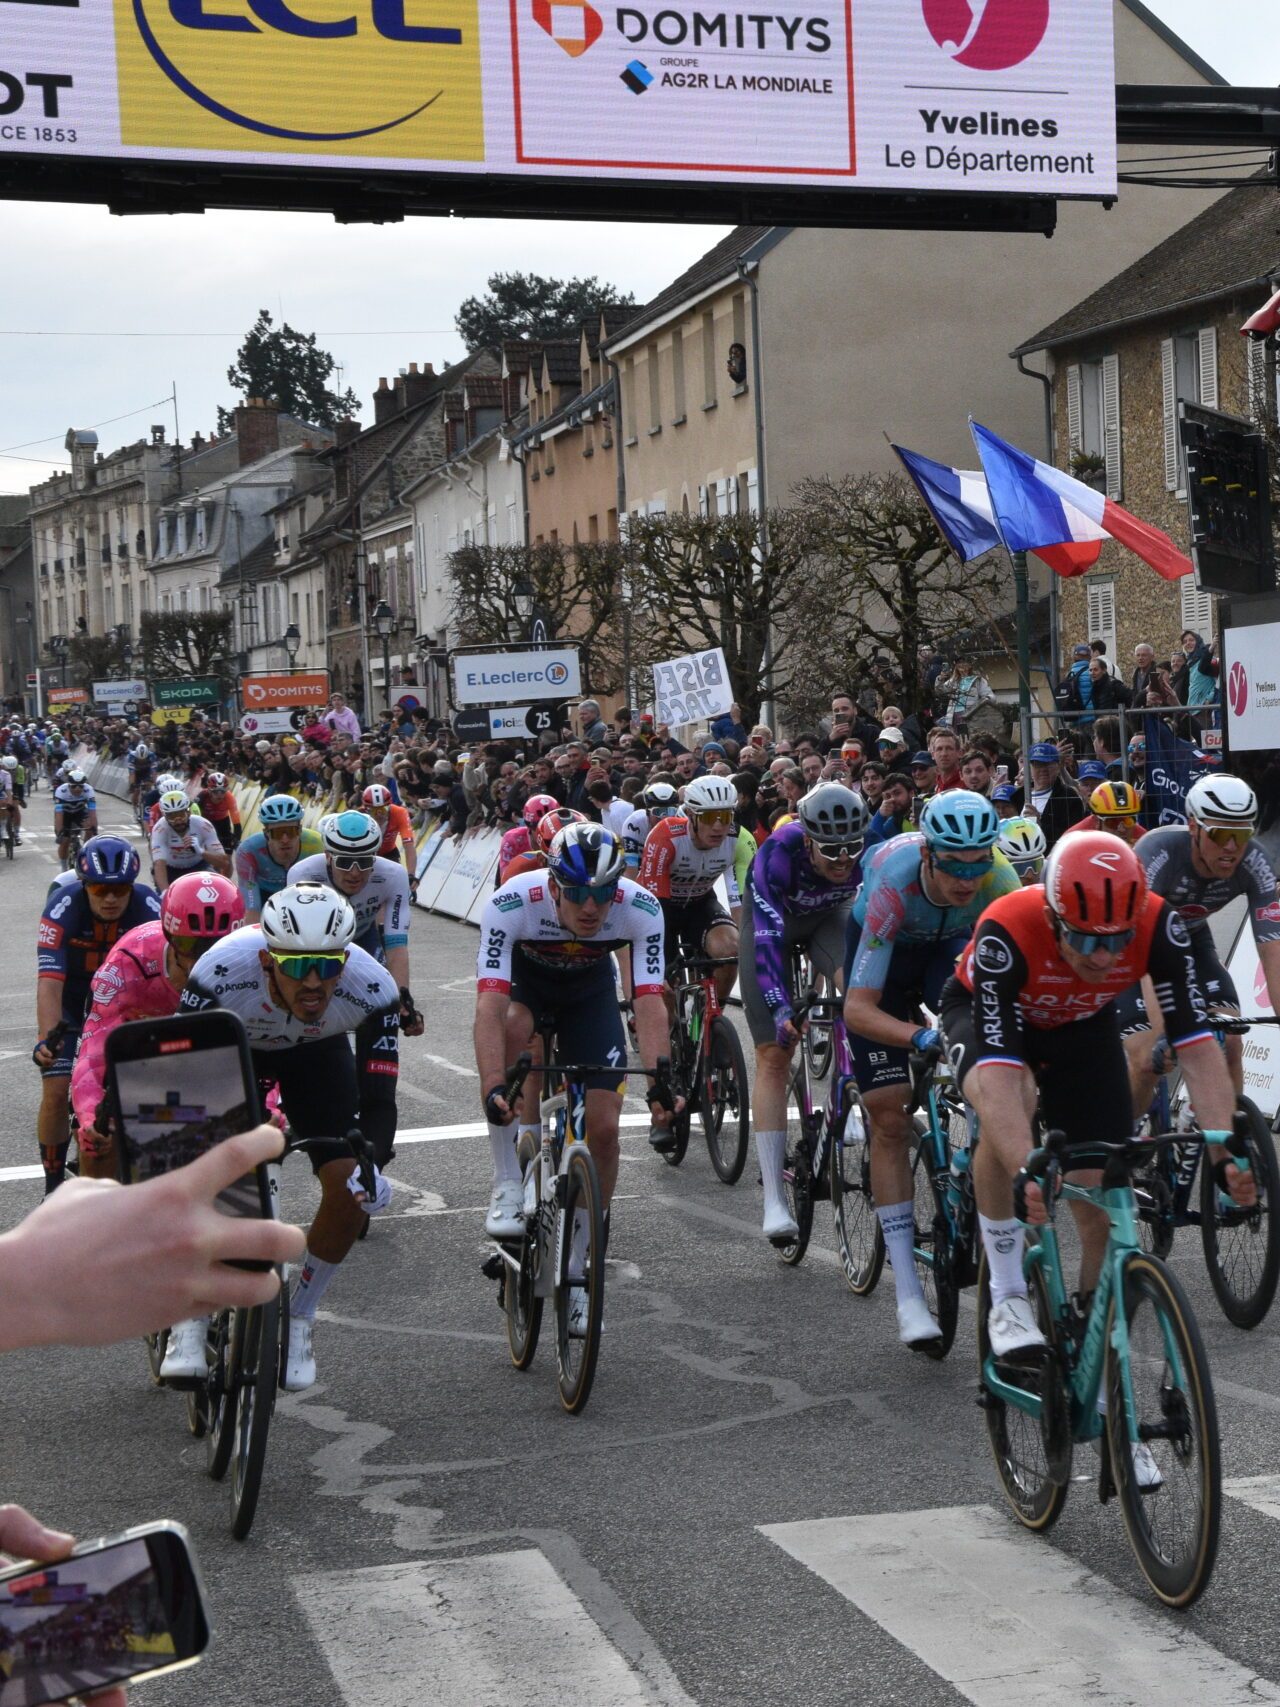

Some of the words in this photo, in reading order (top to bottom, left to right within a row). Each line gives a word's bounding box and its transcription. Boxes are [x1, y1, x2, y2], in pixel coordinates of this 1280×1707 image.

[616, 8, 832, 53] DOMITYS
[660, 56, 699, 68] GROUPE
[661, 72, 708, 90] AG2R
[714, 73, 737, 91] LA
[742, 74, 833, 95] MONDIALE
[919, 110, 1058, 138] Yvelines
[34, 127, 77, 143] 1853
[885, 144, 916, 168] Le
[925, 143, 1094, 176] Département
[467, 671, 543, 686] E.Leclerc
[268, 685, 323, 697] DOMITYS
[502, 717, 516, 728] ici
[535, 712, 551, 729] 25
[296, 893, 327, 905] G42
[492, 891, 521, 908] BORA
[281, 906, 295, 936] MET
[331, 907, 343, 937] MET
[753, 929, 782, 938] ADEX
[486, 928, 506, 969] BOSS
[646, 933, 661, 975] BOSS
[225, 980, 259, 993] Analog
[1183, 955, 1208, 1023] ARKEA
[341, 991, 374, 1014] Analog
[383, 1014, 400, 1028] FA
[981, 980, 1004, 1047] ARKEA
[868, 1051, 888, 1063] B3
[1242, 1040, 1270, 1061] lines
